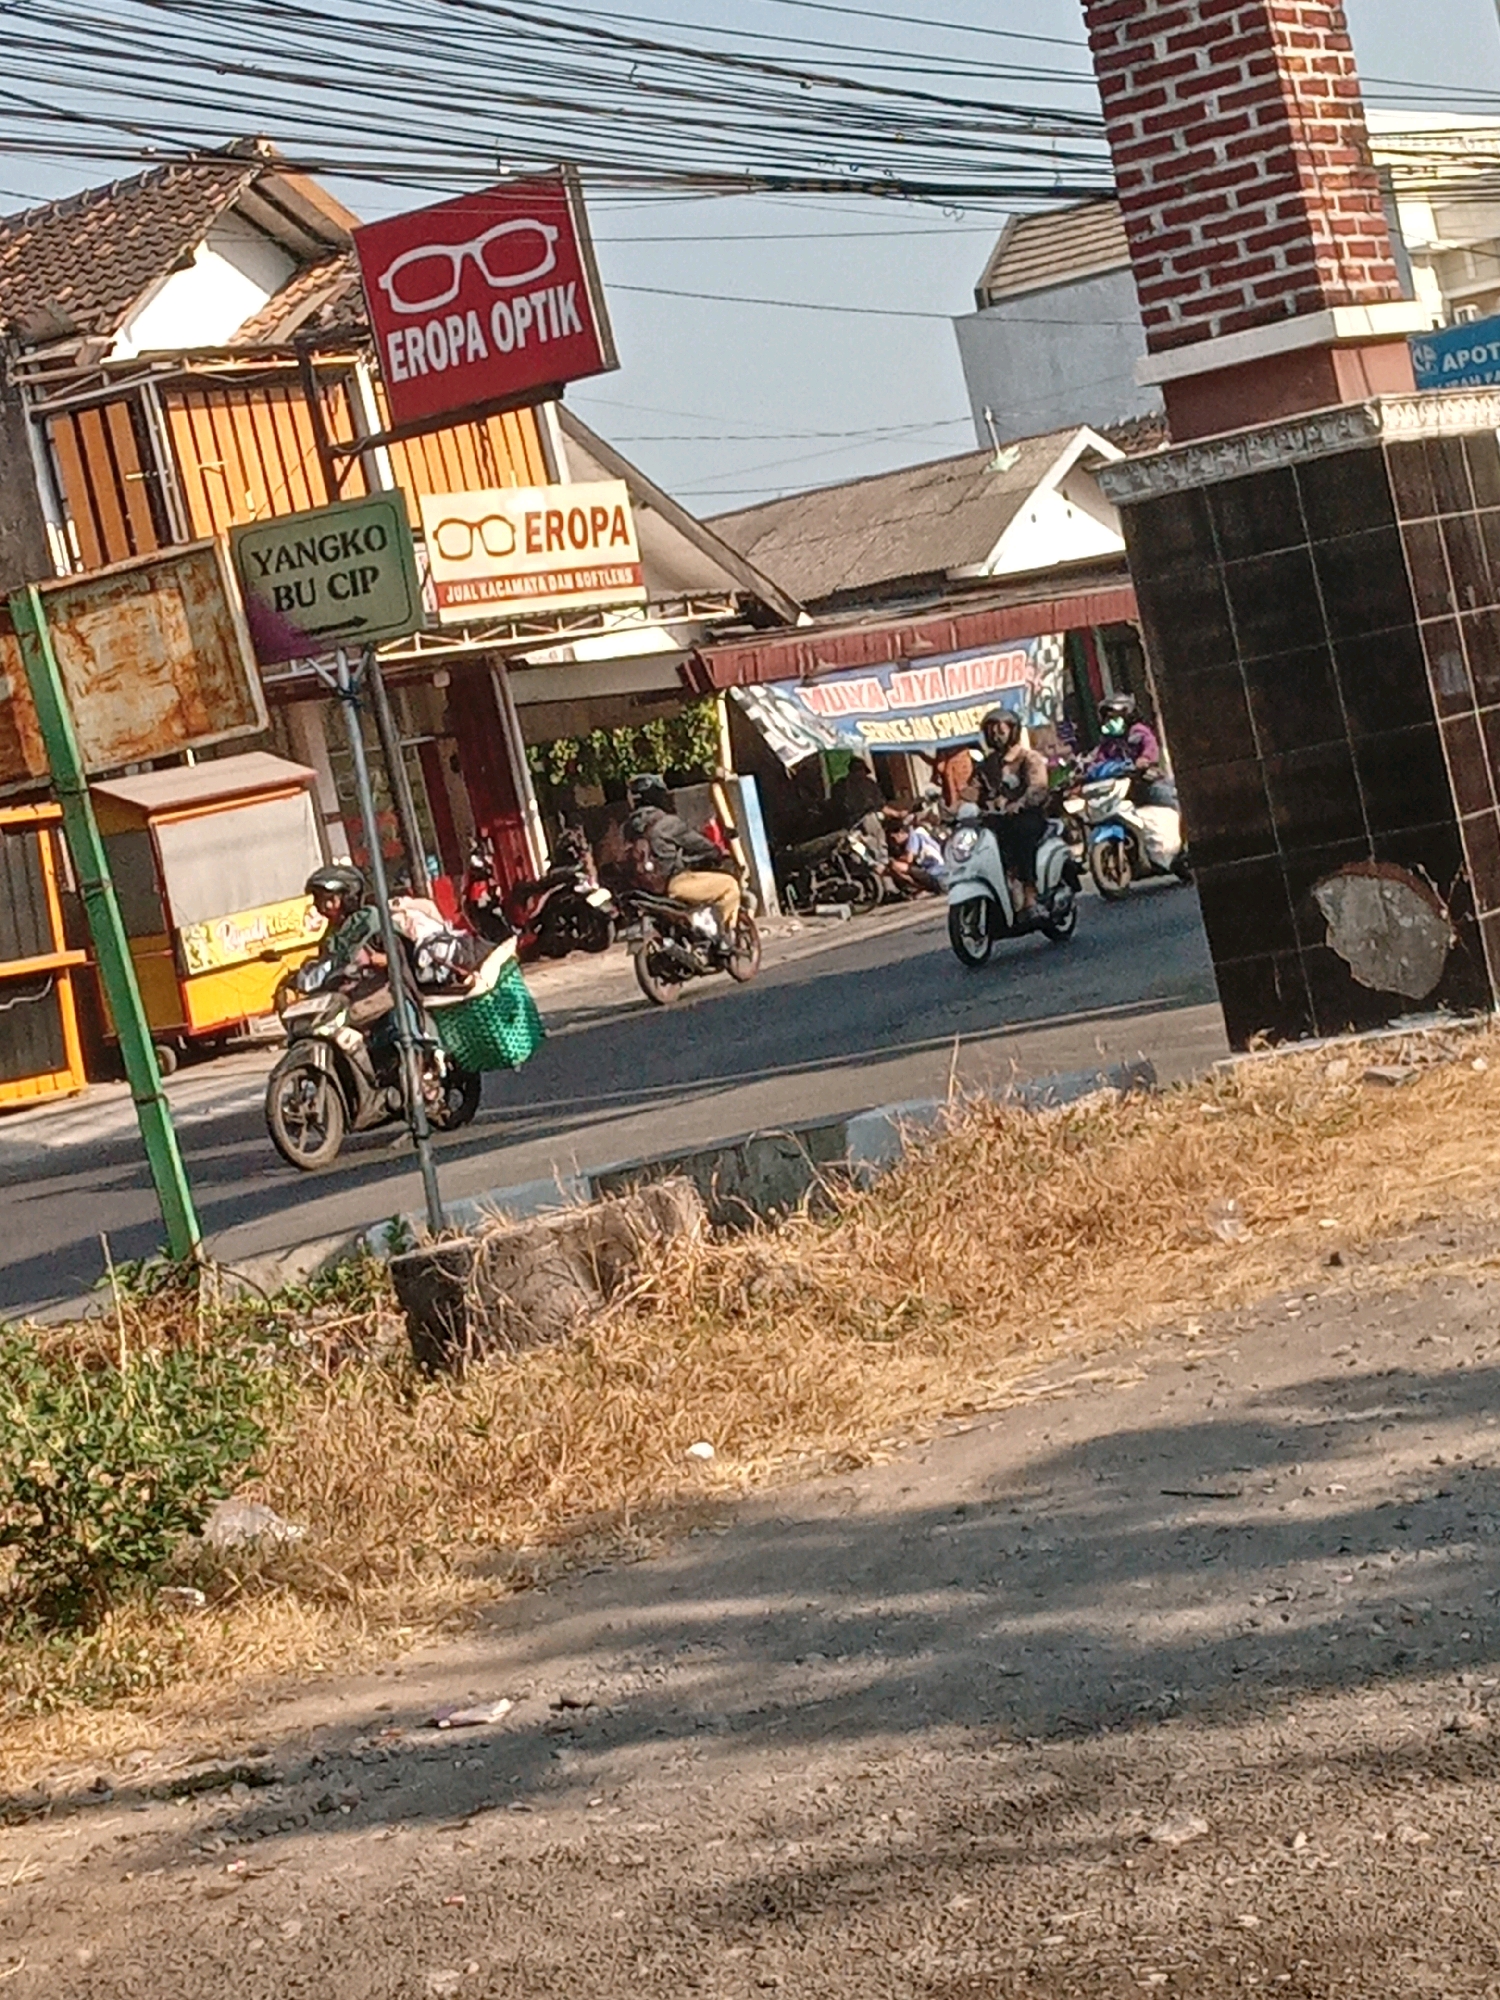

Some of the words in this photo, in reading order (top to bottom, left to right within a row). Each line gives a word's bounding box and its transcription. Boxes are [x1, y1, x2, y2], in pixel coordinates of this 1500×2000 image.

[386, 310, 489, 383] EROPA
[490, 281, 583, 353] OPTIK
[251, 524, 388, 577] YANGKO
[525, 504, 630, 554] EROPA
[272, 578, 316, 613] BU
[327, 566, 380, 600] CIP
[446, 583, 479, 603] JUAL
[547, 573, 574, 592] DAN
[574, 566, 634, 588] SOFTLENS
[887, 669, 946, 705] JAYA
[946, 651, 1026, 698] MOTOR
